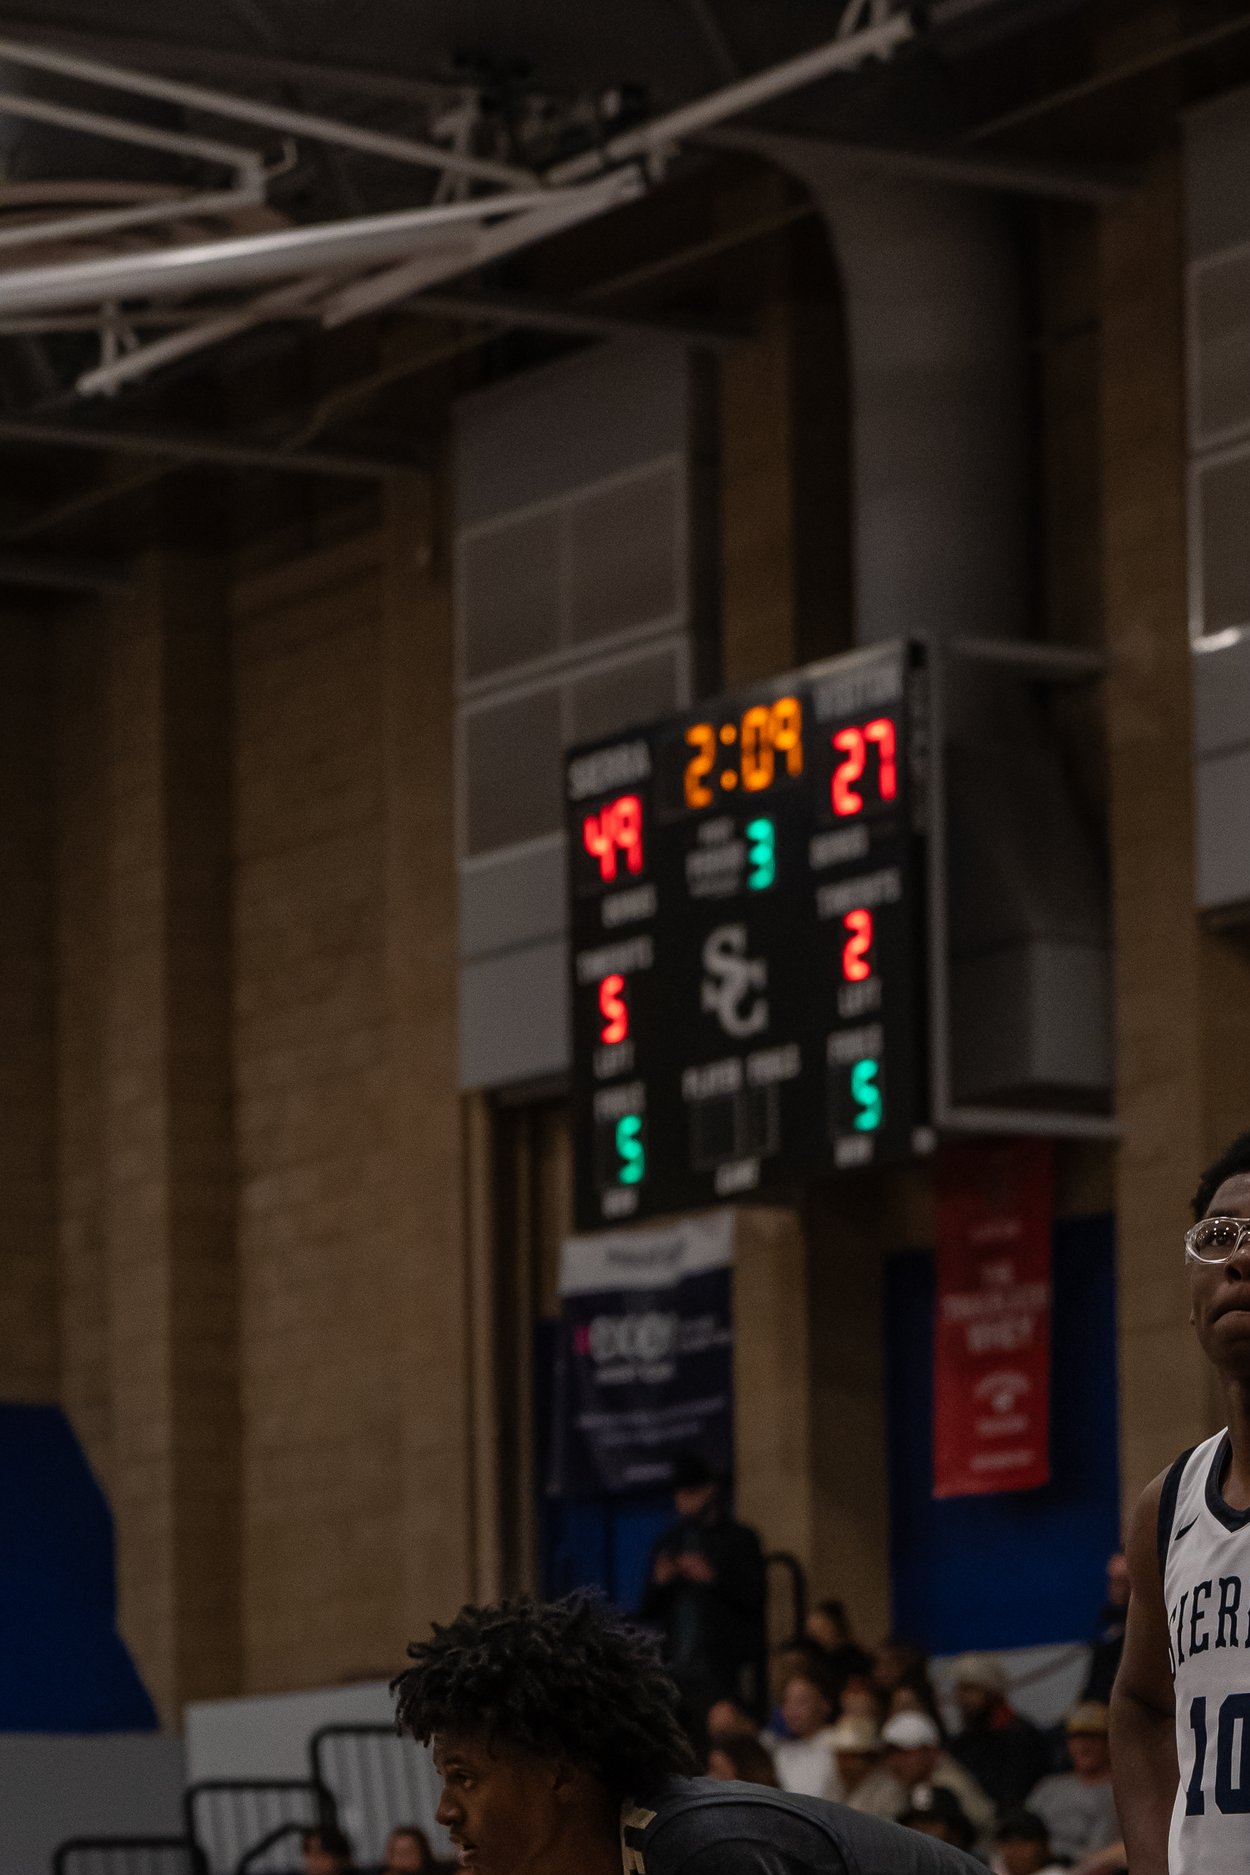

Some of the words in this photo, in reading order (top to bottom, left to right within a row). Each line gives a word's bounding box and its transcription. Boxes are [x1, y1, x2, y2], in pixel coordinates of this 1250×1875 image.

[684, 695, 803, 809] 2:09
[830, 715, 898, 817] 27
[582, 793, 644, 882] 49
[745, 816, 776, 890] 3
[841, 907, 874, 983] 2
[598, 972, 630, 1046] 5
[850, 1057, 882, 1132] 5
[614, 1112, 645, 1185] 5
